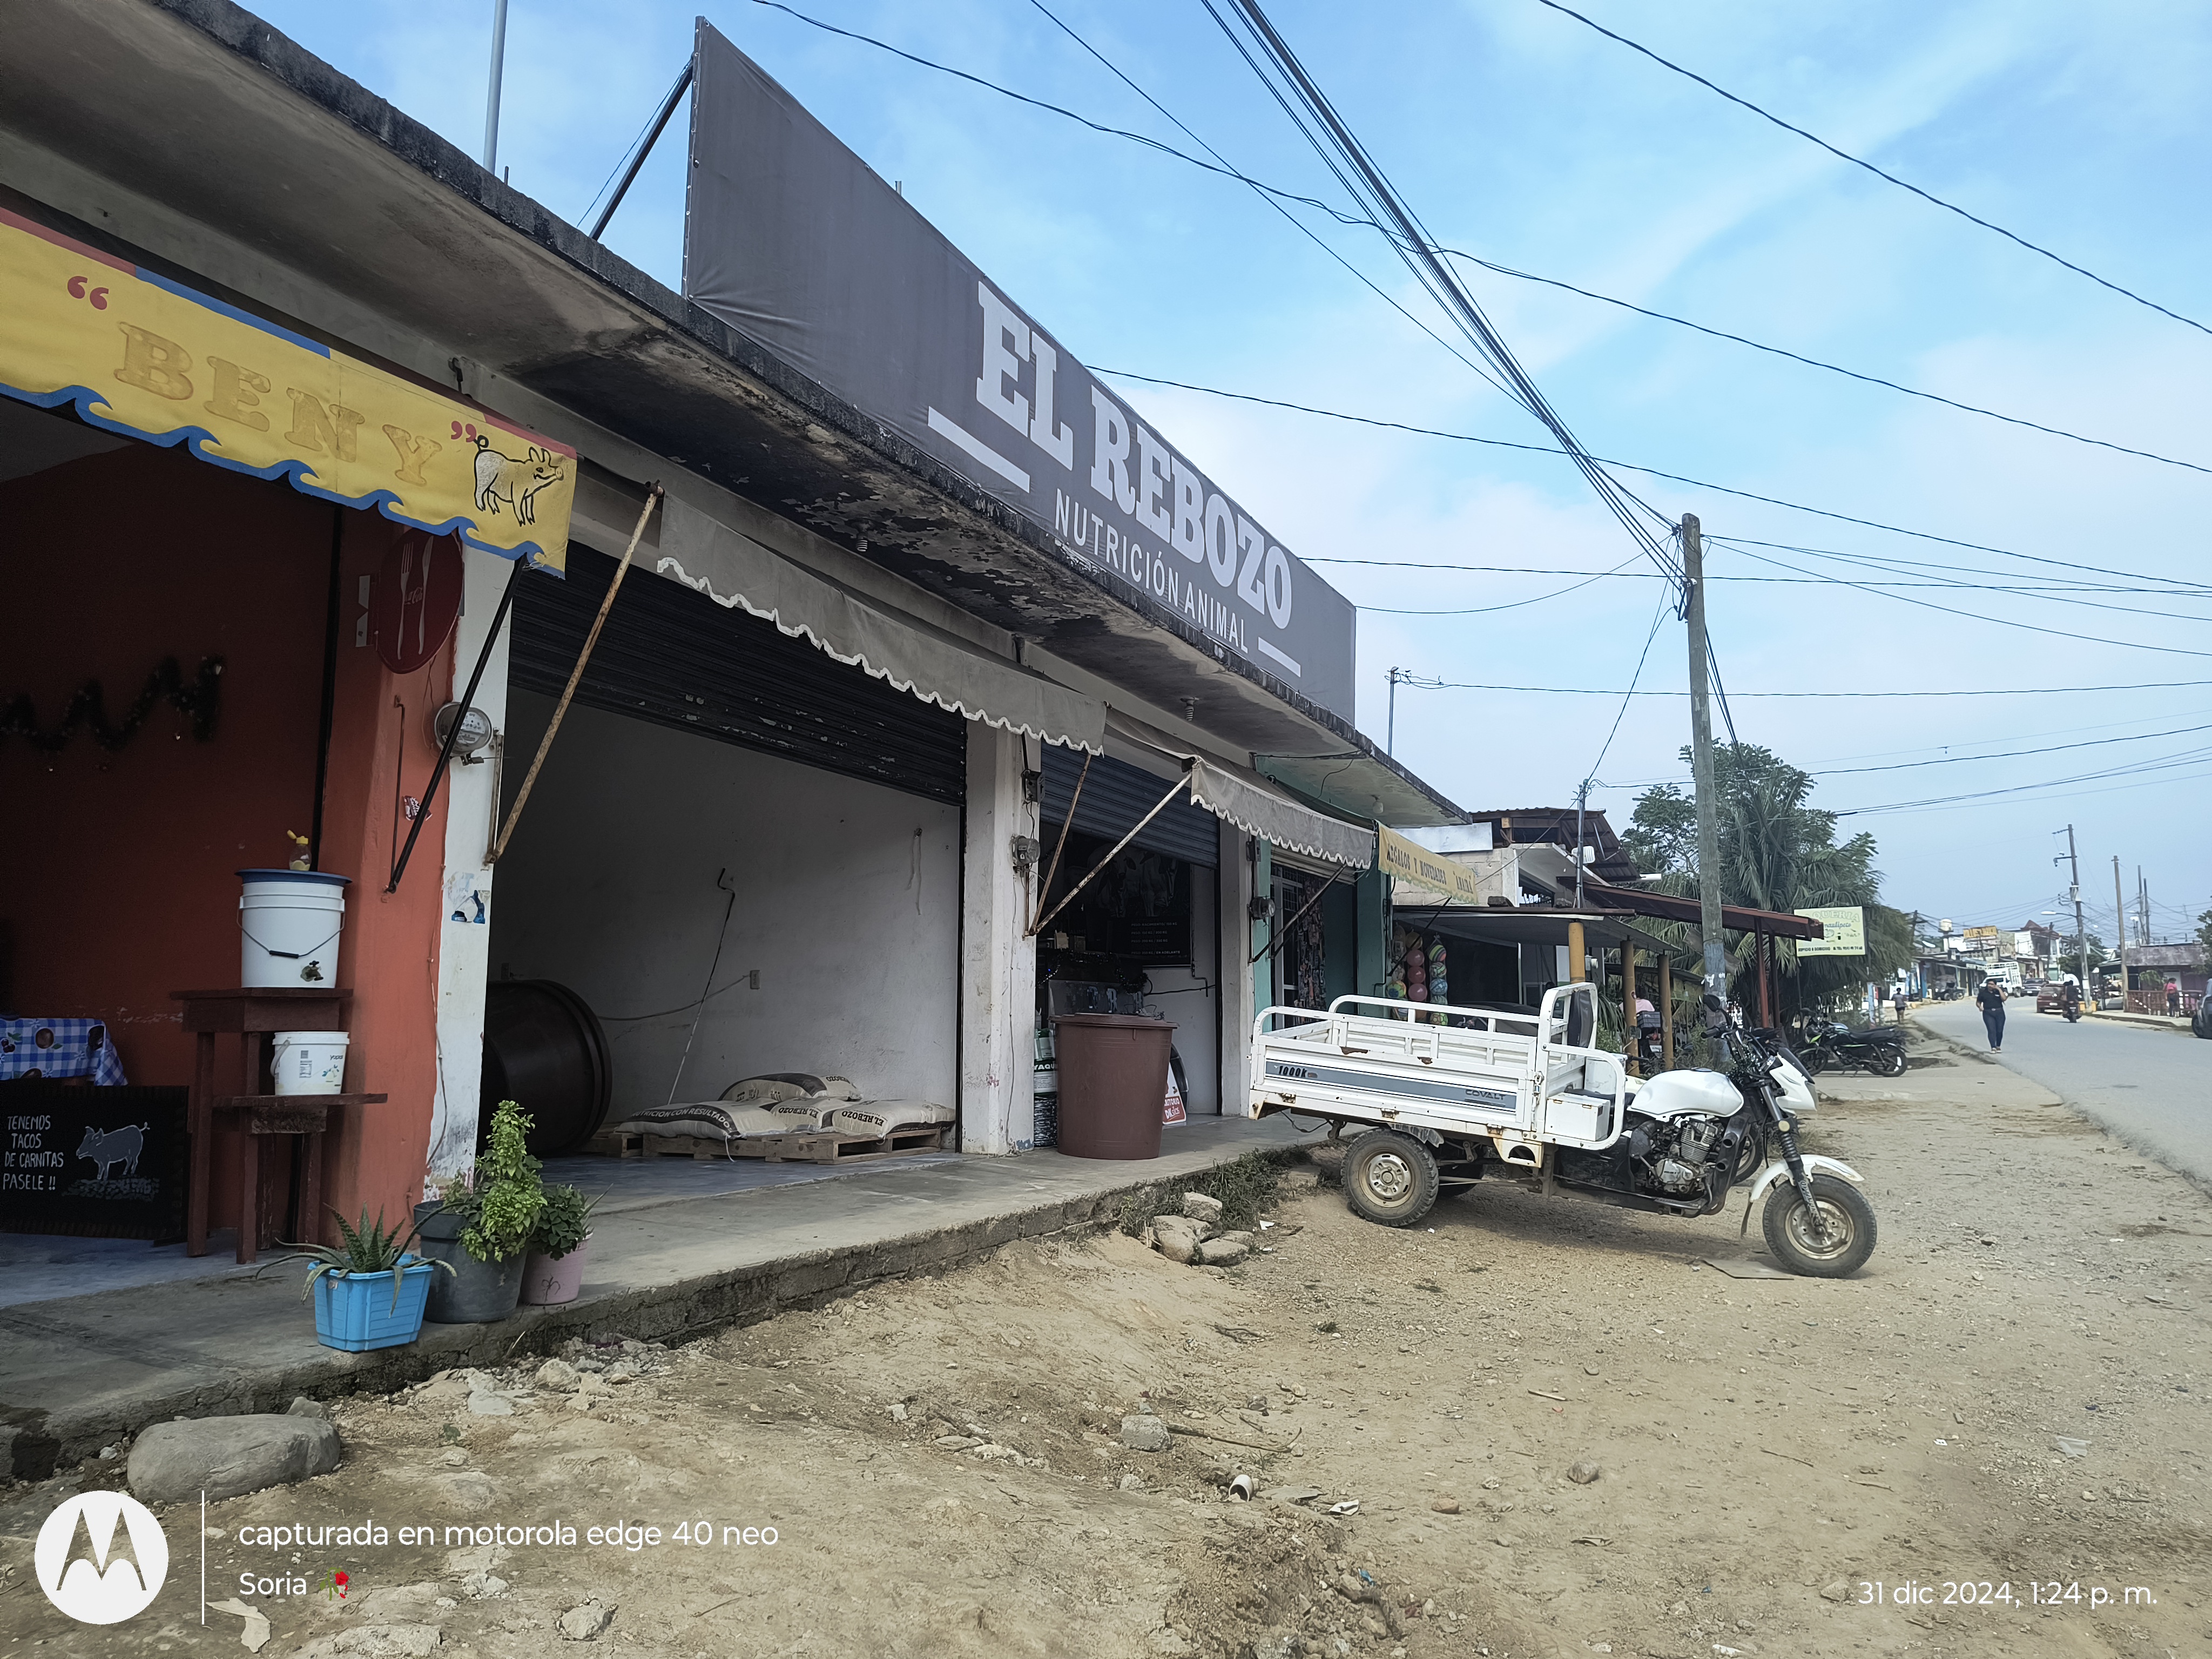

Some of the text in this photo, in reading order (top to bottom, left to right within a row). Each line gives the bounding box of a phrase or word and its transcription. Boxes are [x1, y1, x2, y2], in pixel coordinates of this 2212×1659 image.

[976, 281, 1292, 630] EL REBOZO
[1055, 488, 1249, 654] NUTRICIÓN ANIMAL
[1386, 843, 1411, 871] REGALOS
[1413, 857, 1418, 874] Y
[1465, 1089, 1507, 1100] COVALT
[671, 1109, 689, 1117] CON
[778, 1107, 819, 1119] EL REBOZO
[842, 1110, 874, 1123] REBOZO
[8, 1115, 51, 1131] TENEMOS
[874, 1116, 885, 1127] EL
[11, 1133, 42, 1149] TACOS
[4, 1151, 64, 1168] DE CARNITAS
[3, 1173, 44, 1190] PASELE
